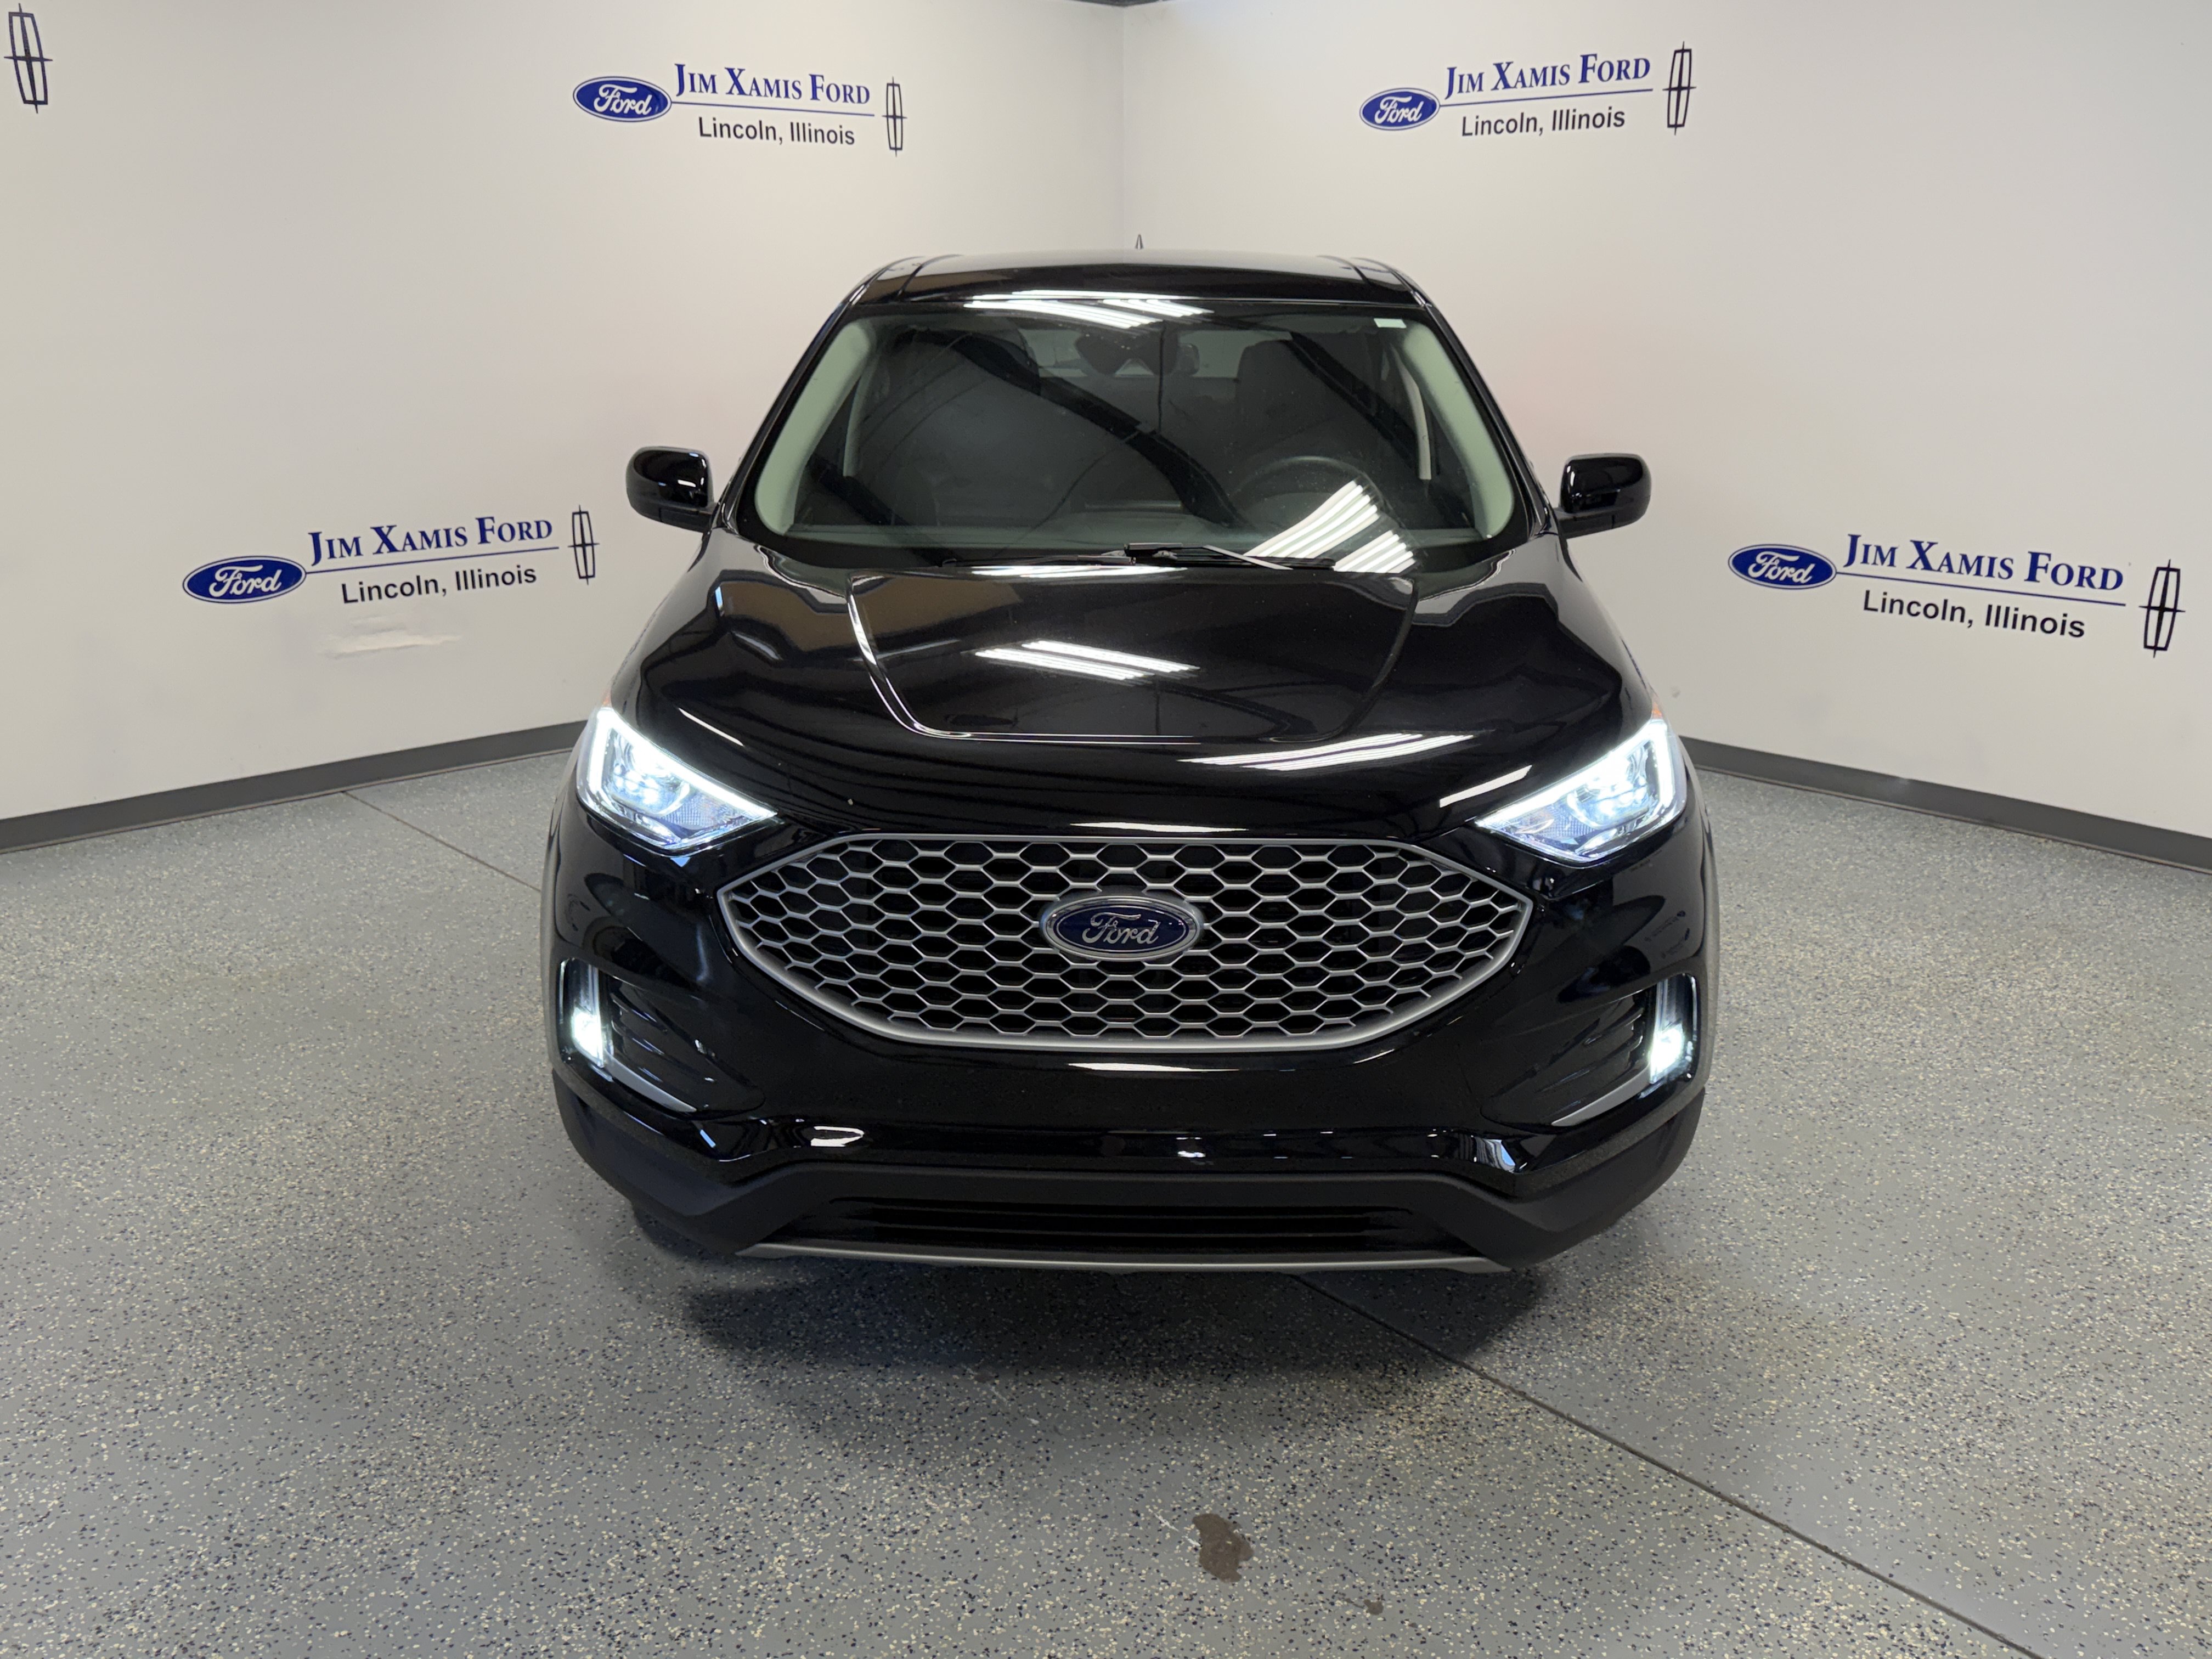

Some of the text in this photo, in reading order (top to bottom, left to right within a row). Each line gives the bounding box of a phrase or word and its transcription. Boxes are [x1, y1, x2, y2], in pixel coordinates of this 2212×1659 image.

[594, 84, 653, 116] Ford
[1374, 95, 1423, 124] Ford
[699, 117, 854, 145] Lincoln, Illinois
[1463, 106, 1624, 136] Lincoln, Illinois
[208, 565, 282, 597] Ford
[1748, 551, 1813, 584] Ford
[342, 565, 536, 603] Lincoln, Illinois
[1864, 589, 2084, 637] Lincoln, Illinois
[1082, 912, 1160, 944] Ford
